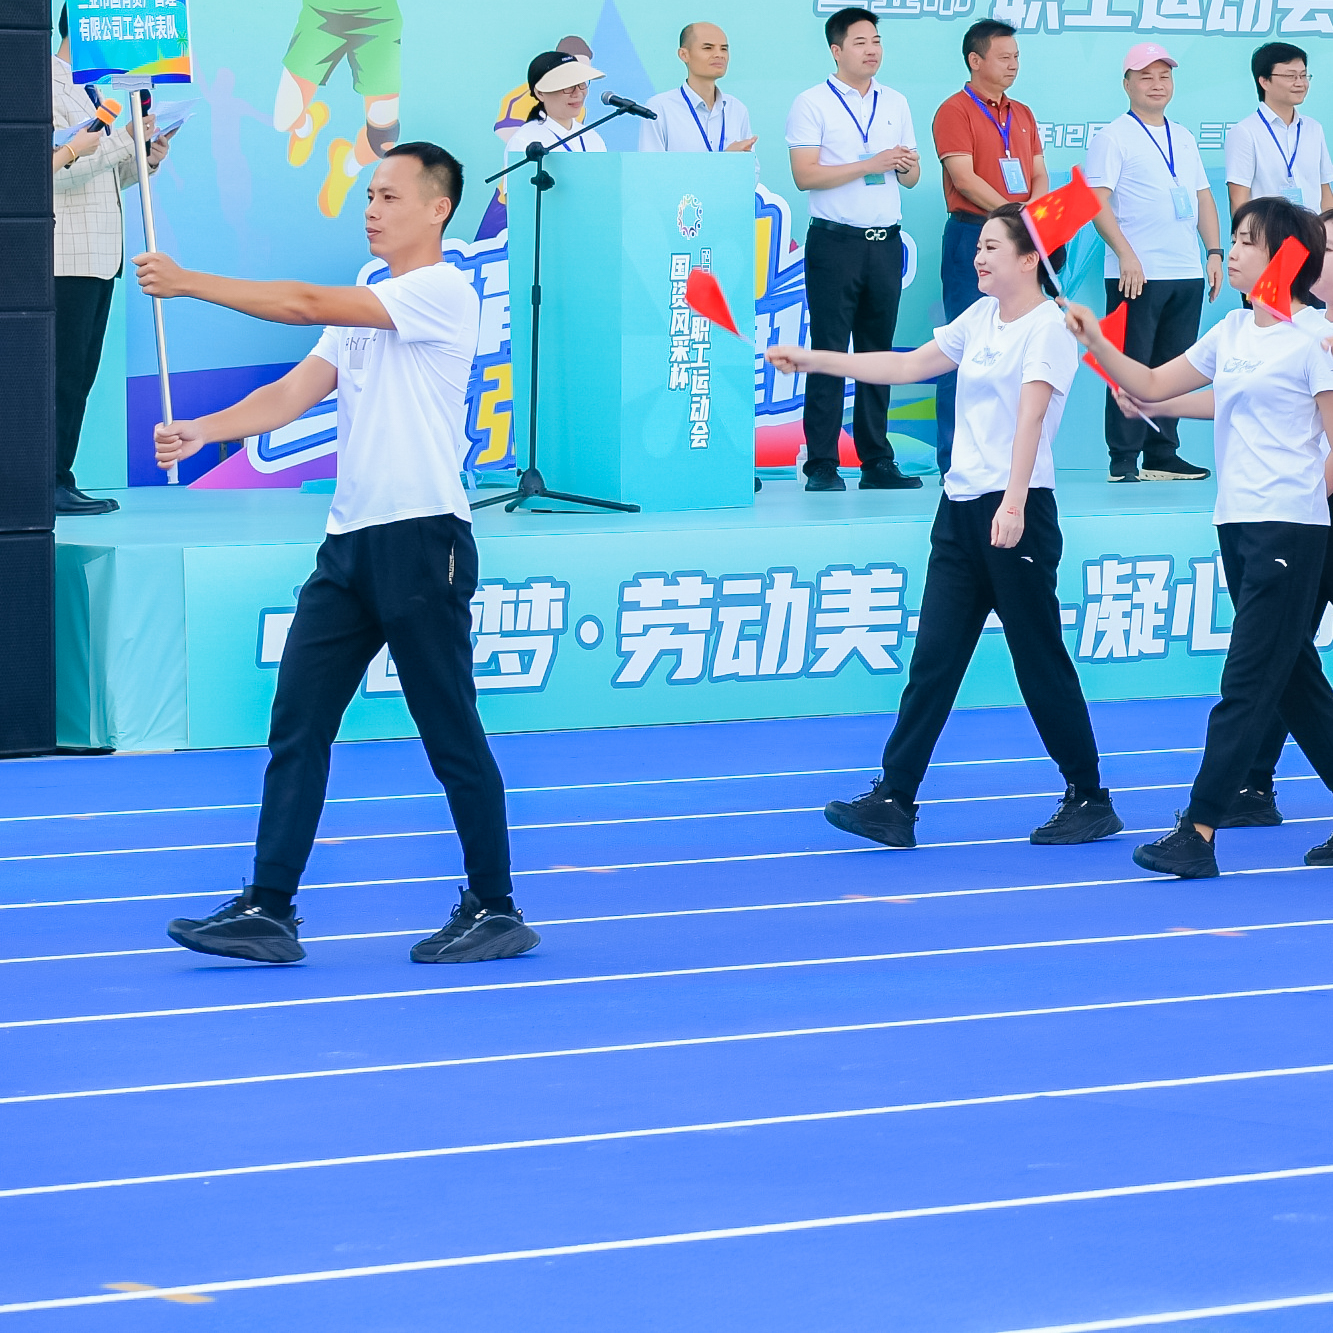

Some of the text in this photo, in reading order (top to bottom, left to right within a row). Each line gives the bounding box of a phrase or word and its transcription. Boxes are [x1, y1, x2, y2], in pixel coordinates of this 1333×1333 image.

[78, 13, 180, 42] 有限公司工会代表队
[669, 253, 692, 391] 国资风采杯
[689, 316, 711, 450] 职工运动会
